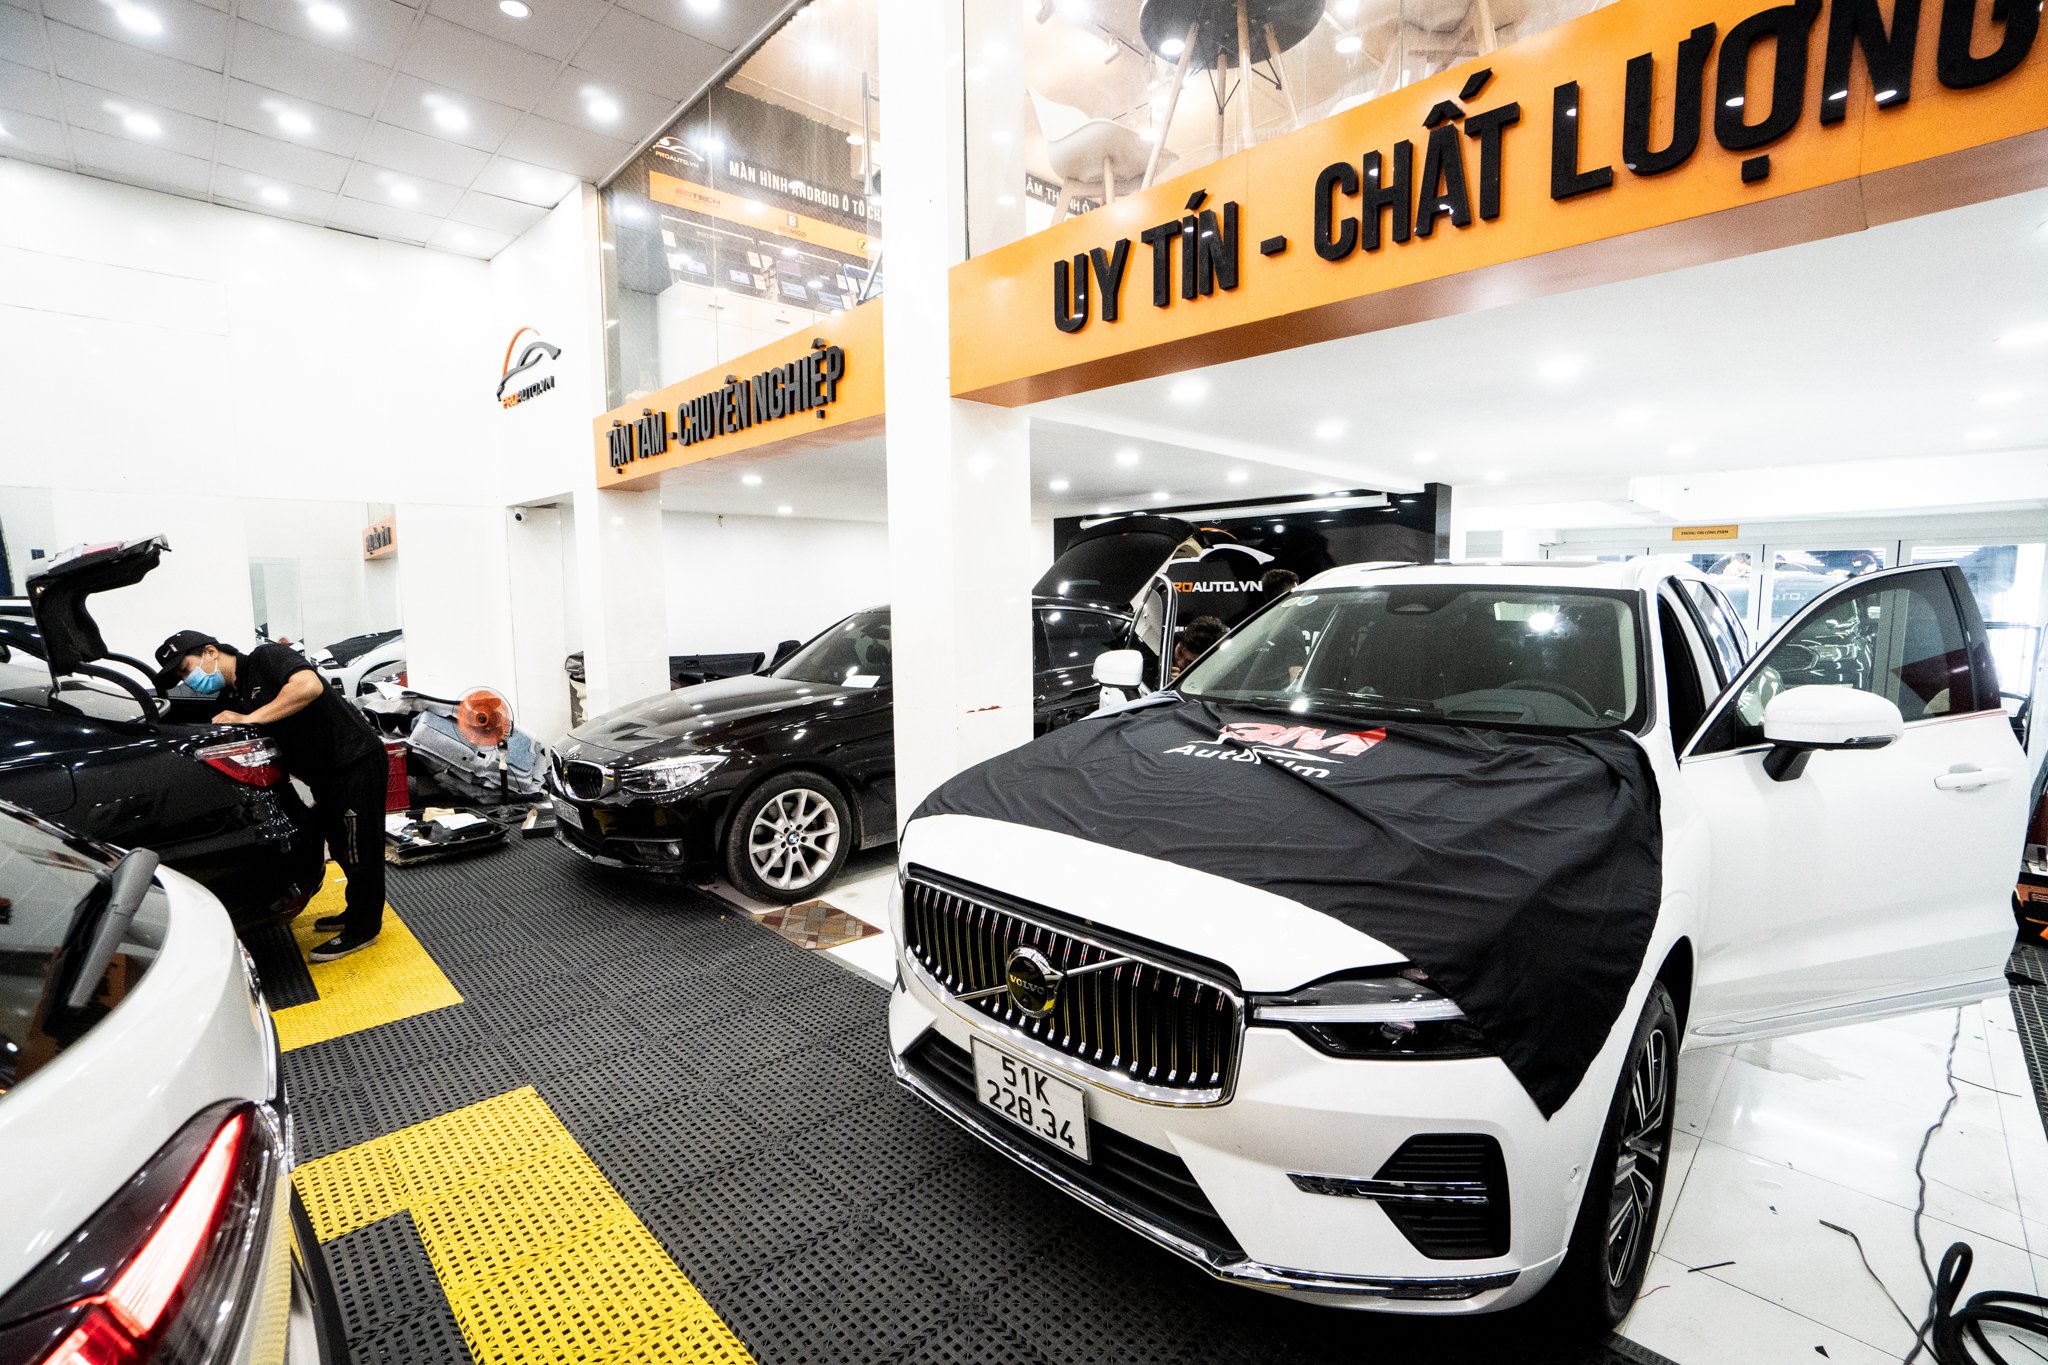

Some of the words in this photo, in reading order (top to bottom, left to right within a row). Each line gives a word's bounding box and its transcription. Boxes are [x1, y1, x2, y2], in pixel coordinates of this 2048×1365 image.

[729, 160, 756, 183] MÀN
[760, 170, 788, 193] HÌNH
[842, 194, 849, 212] Ô
[852, 199, 865, 217] TÔ
[867, 208, 881, 223] CH
[1054, 238, 1130, 333] UY
[1141, 189, 1239, 307] TÍN
[1260, 235, 1287, 256] -
[1313, 67, 1521, 261] CHẤT
[1551, 0, 2042, 201] LƯỢNG
[606, 419, 634, 475] TẬN
[633, 408, 667, 459] TÂM
[677, 374, 751, 446] CHUYÊN
[752, 337, 846, 425] NGHIỆP
[1173, 580, 1263, 593] ROAUTO.VN
[1010, 974, 1045, 995] VOLVO
[1002, 1055, 1050, 1105] 51K
[987, 1079, 1075, 1149] 228.34
